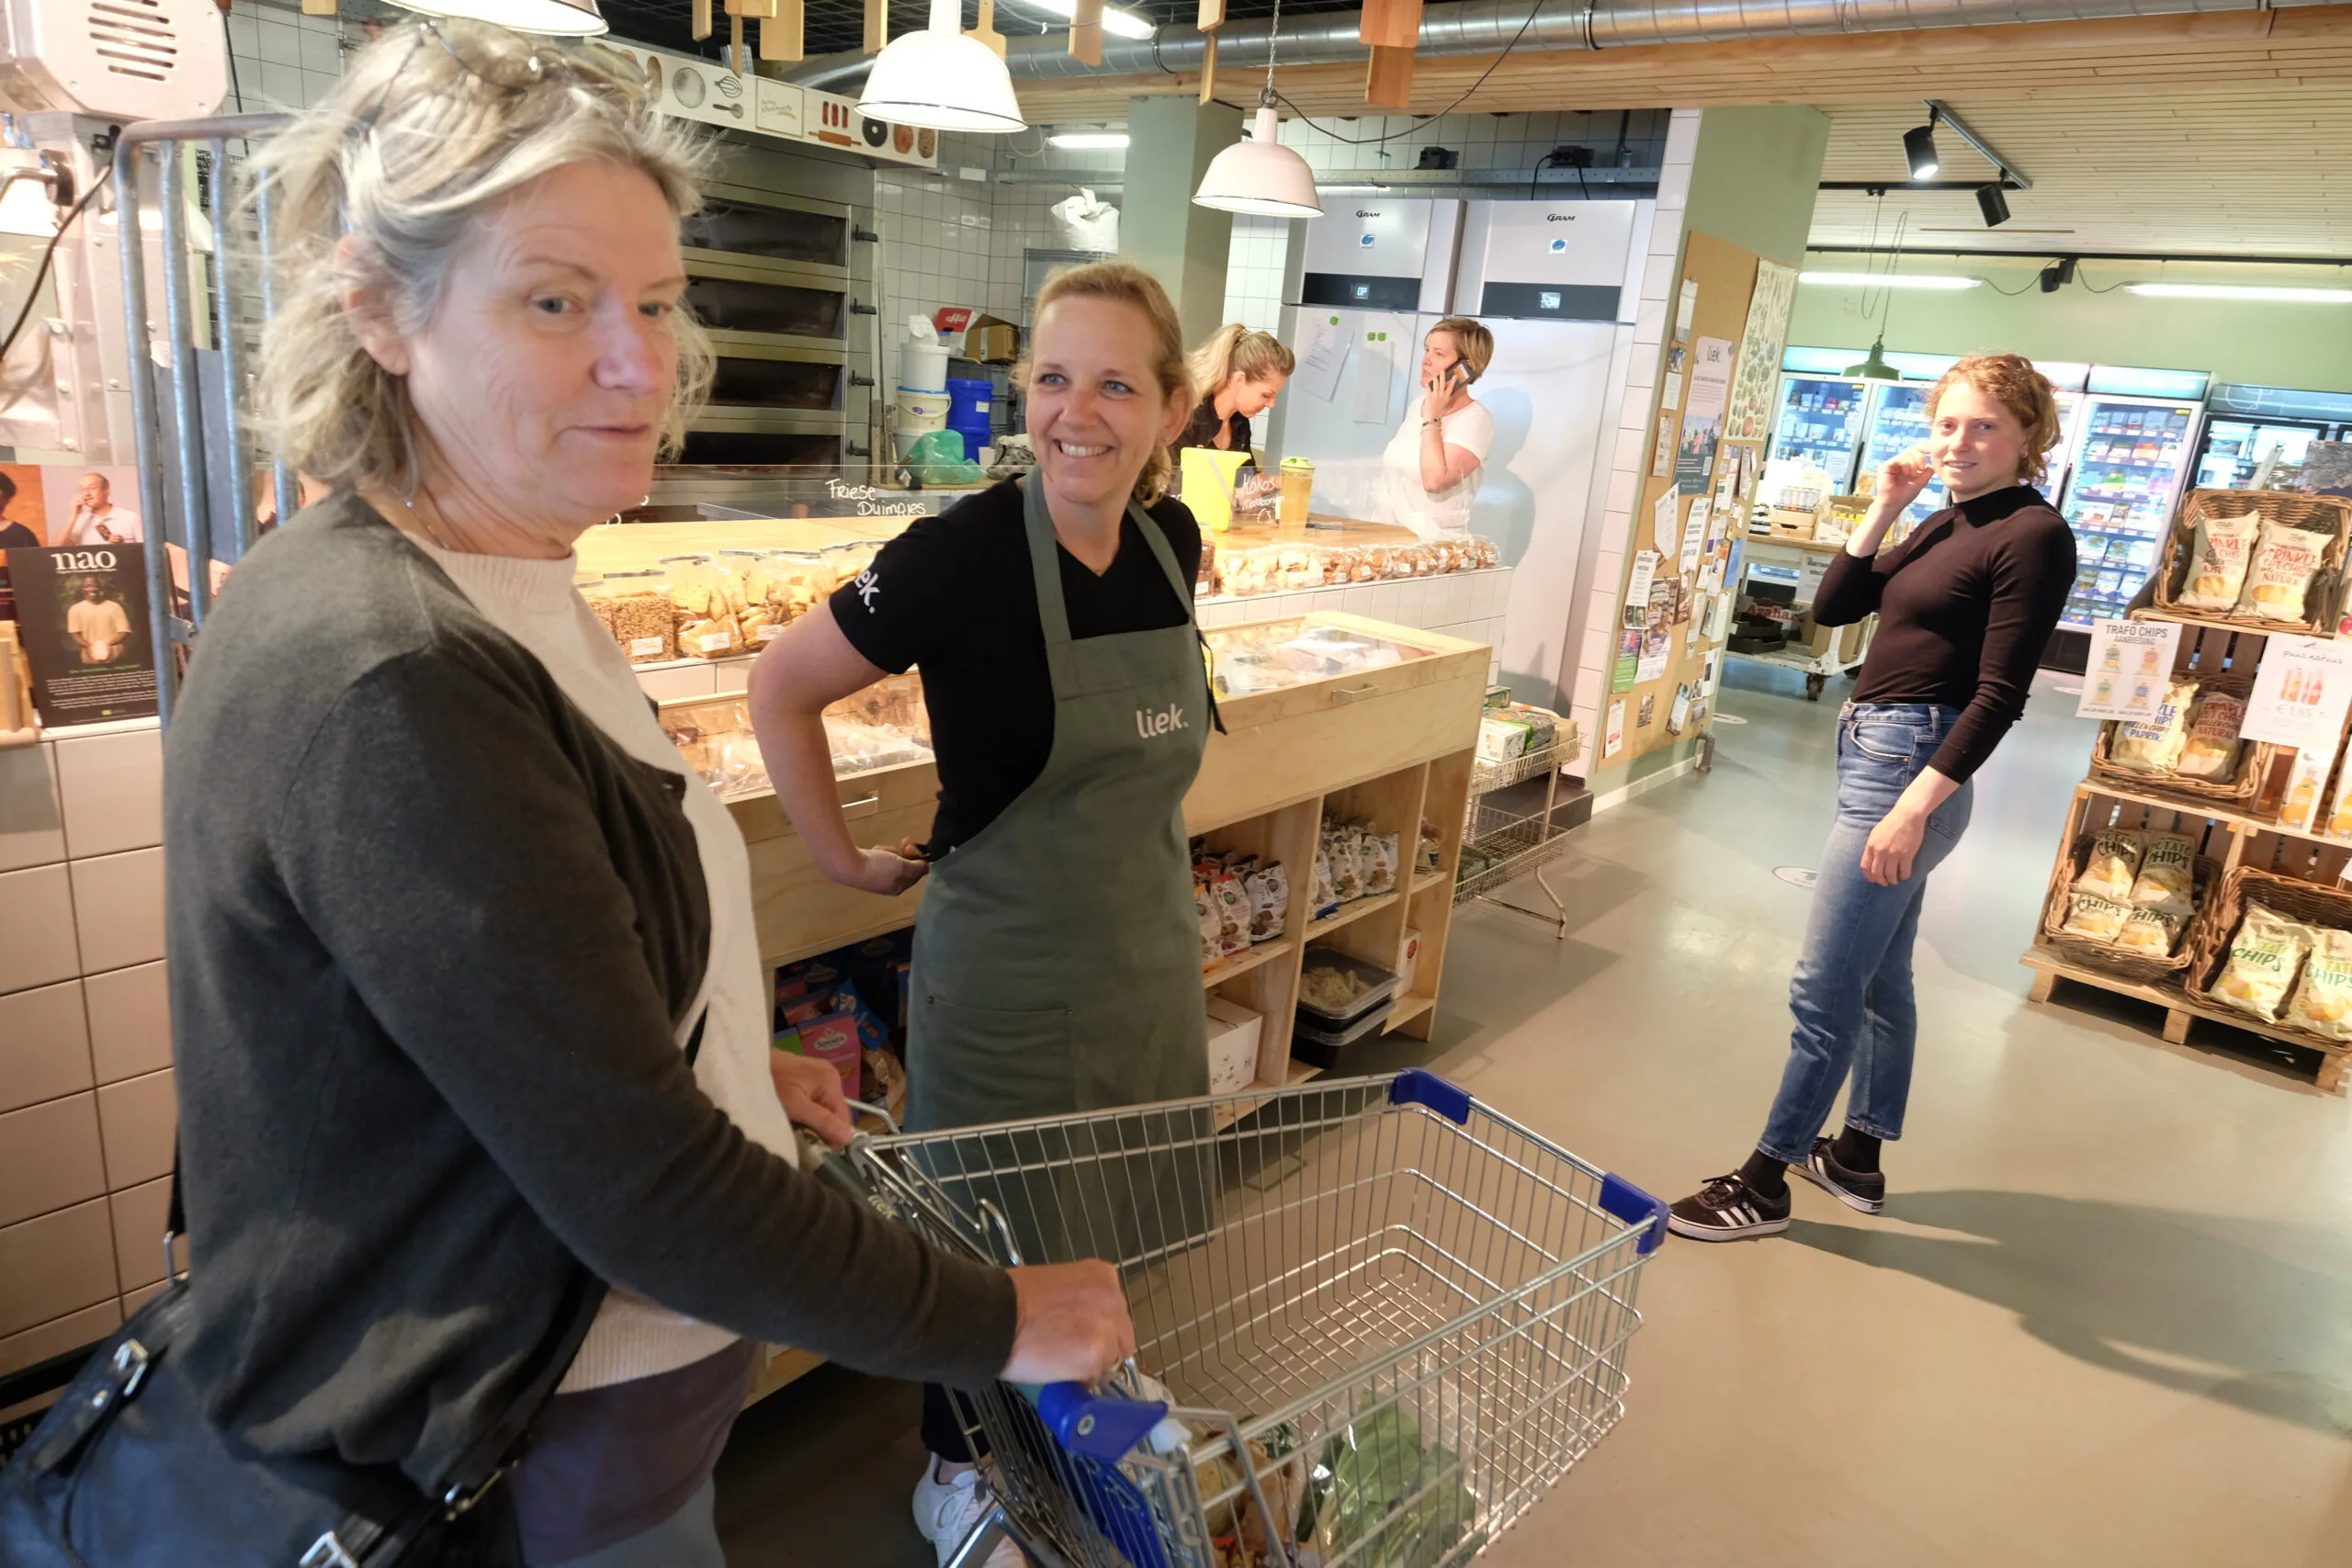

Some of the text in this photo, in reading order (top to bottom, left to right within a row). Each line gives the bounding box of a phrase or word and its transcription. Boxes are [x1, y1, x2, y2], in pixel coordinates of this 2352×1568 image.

[1355, 209, 1381, 219] GRAM
[1546, 213, 1577, 222] GRAM
[50, 550, 118, 570] nao
[854, 569, 881, 615] ek.
[1748, 604, 1793, 620] Azaha
[2105, 624, 2169, 639] TRAFO CHIPS
[1136, 703, 1190, 739] liek.
[2097, 840, 2136, 864] CHIPS
[2232, 947, 2288, 973] CHIPS
